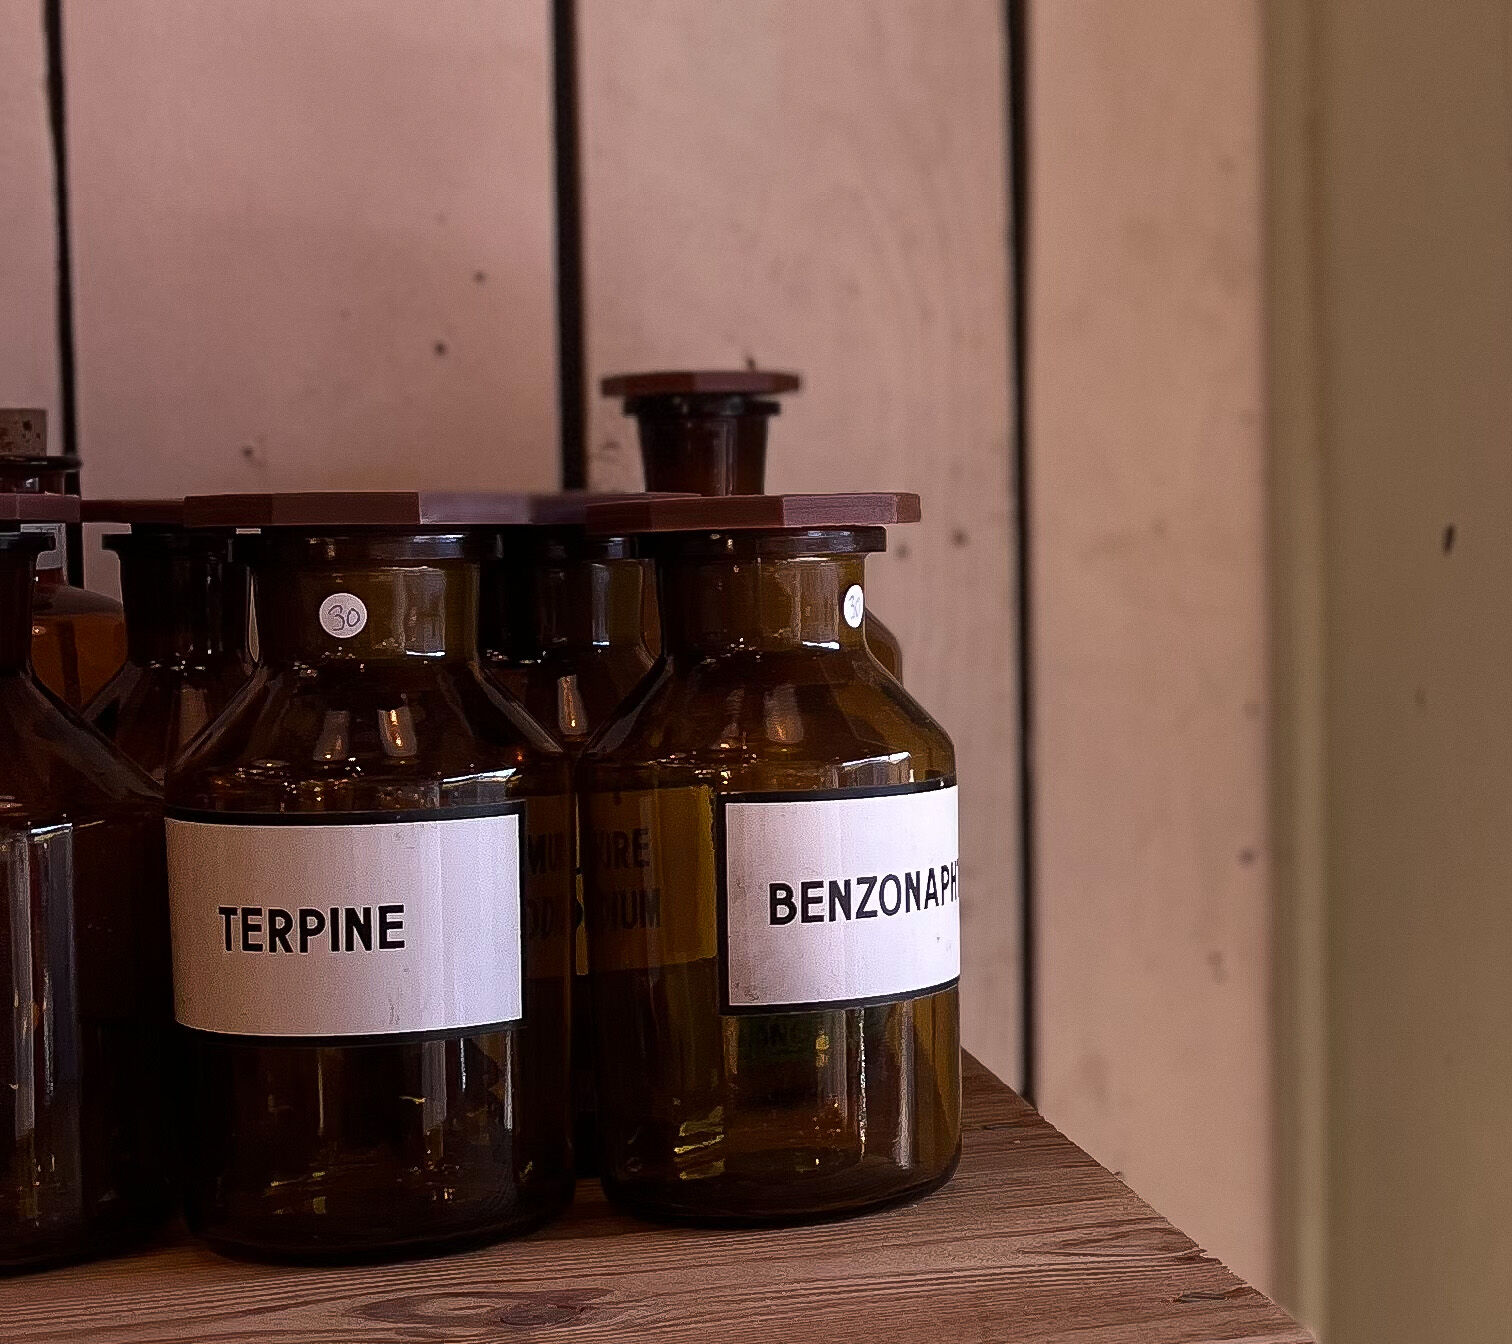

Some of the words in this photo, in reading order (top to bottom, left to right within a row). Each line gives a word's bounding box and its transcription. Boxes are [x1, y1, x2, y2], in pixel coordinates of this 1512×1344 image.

[328, 605, 360, 631] 30
[769, 859, 958, 926] BENZONAPH
[218, 904, 405, 954] TERPINE
